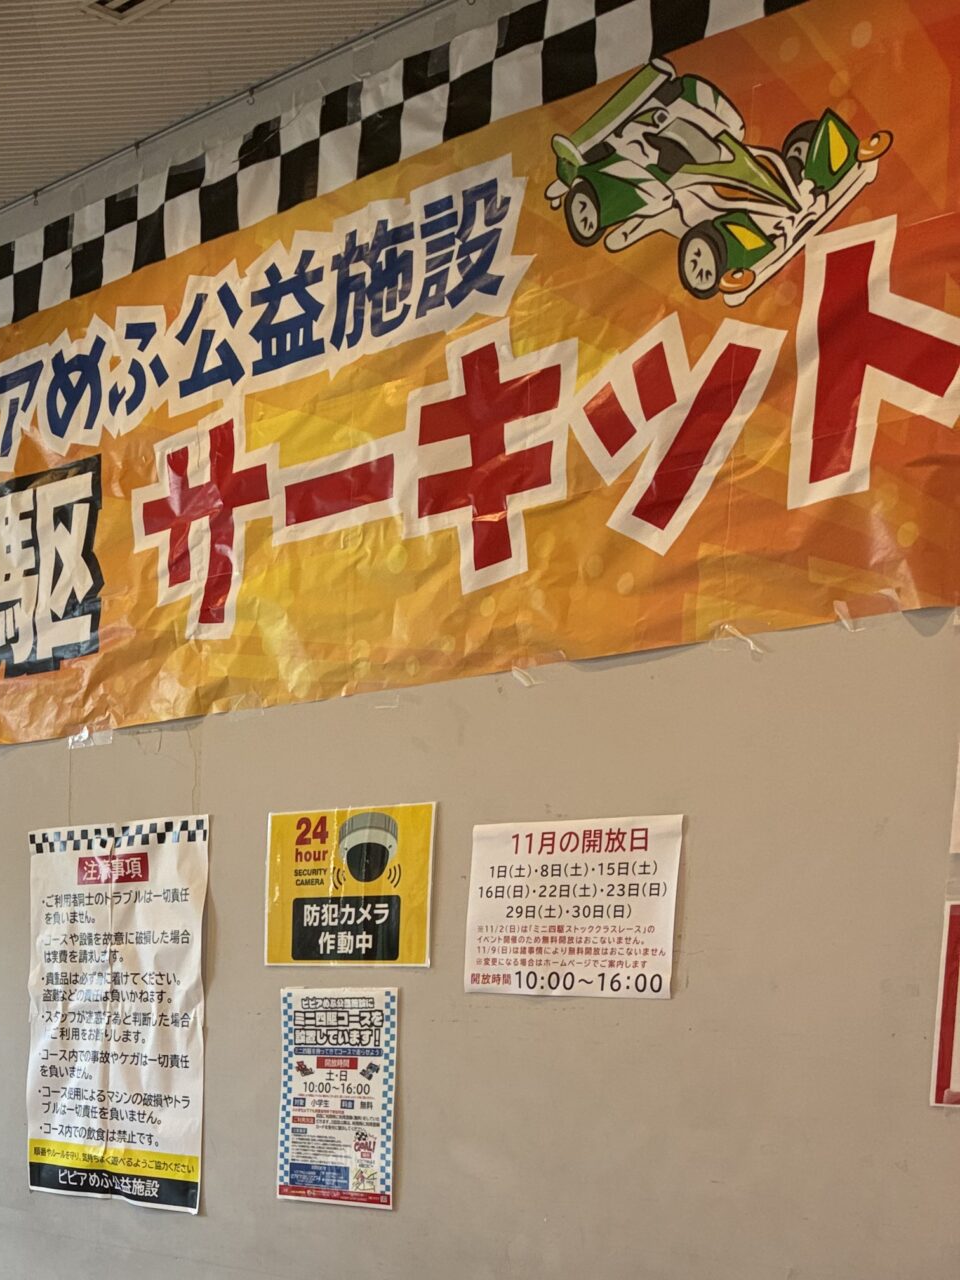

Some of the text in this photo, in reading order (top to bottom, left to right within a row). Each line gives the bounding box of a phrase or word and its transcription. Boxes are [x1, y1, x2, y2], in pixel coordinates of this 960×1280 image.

[139, 240, 960, 626] サーキット
[295, 816, 329, 846] 24
[512, 827, 649, 855] 11月の開放日
[295, 848, 329, 863] hour
[294, 868, 328, 877] SECURITY
[303, 904, 390, 927] 防犯カメラ
[318, 931, 373, 954] 作動中
[470, 973, 512, 985] 開放時間
[58, 1169, 160, 1198] ピピアめふ公益施設
